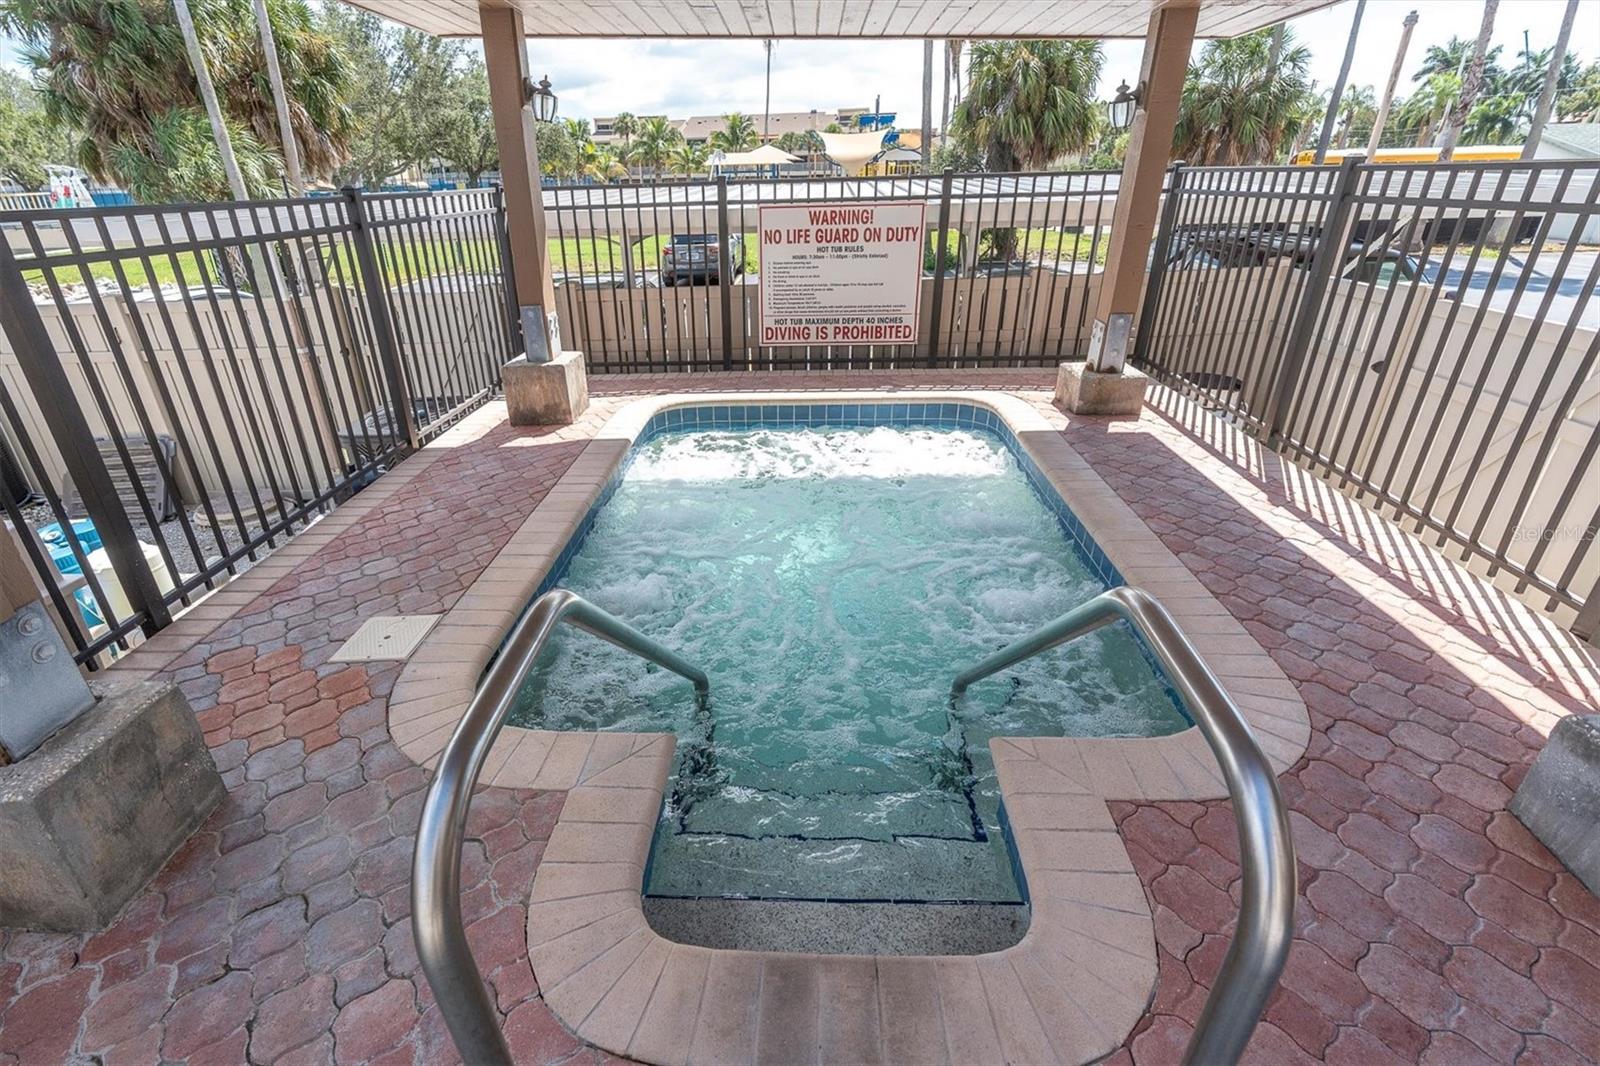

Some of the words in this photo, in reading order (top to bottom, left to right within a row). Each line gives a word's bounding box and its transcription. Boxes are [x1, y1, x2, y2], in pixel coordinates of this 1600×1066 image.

[809, 210, 874, 225] WARNING!
[764, 230, 782, 244] NO
[787, 229, 810, 244] LIFE
[816, 228, 858, 243] GUARD
[864, 228, 881, 242] ON
[887, 227, 919, 242] DUTY
[766, 327, 810, 340] DIVING
[816, 326, 828, 340] IS
[834, 325, 911, 339] PROHIBITED
